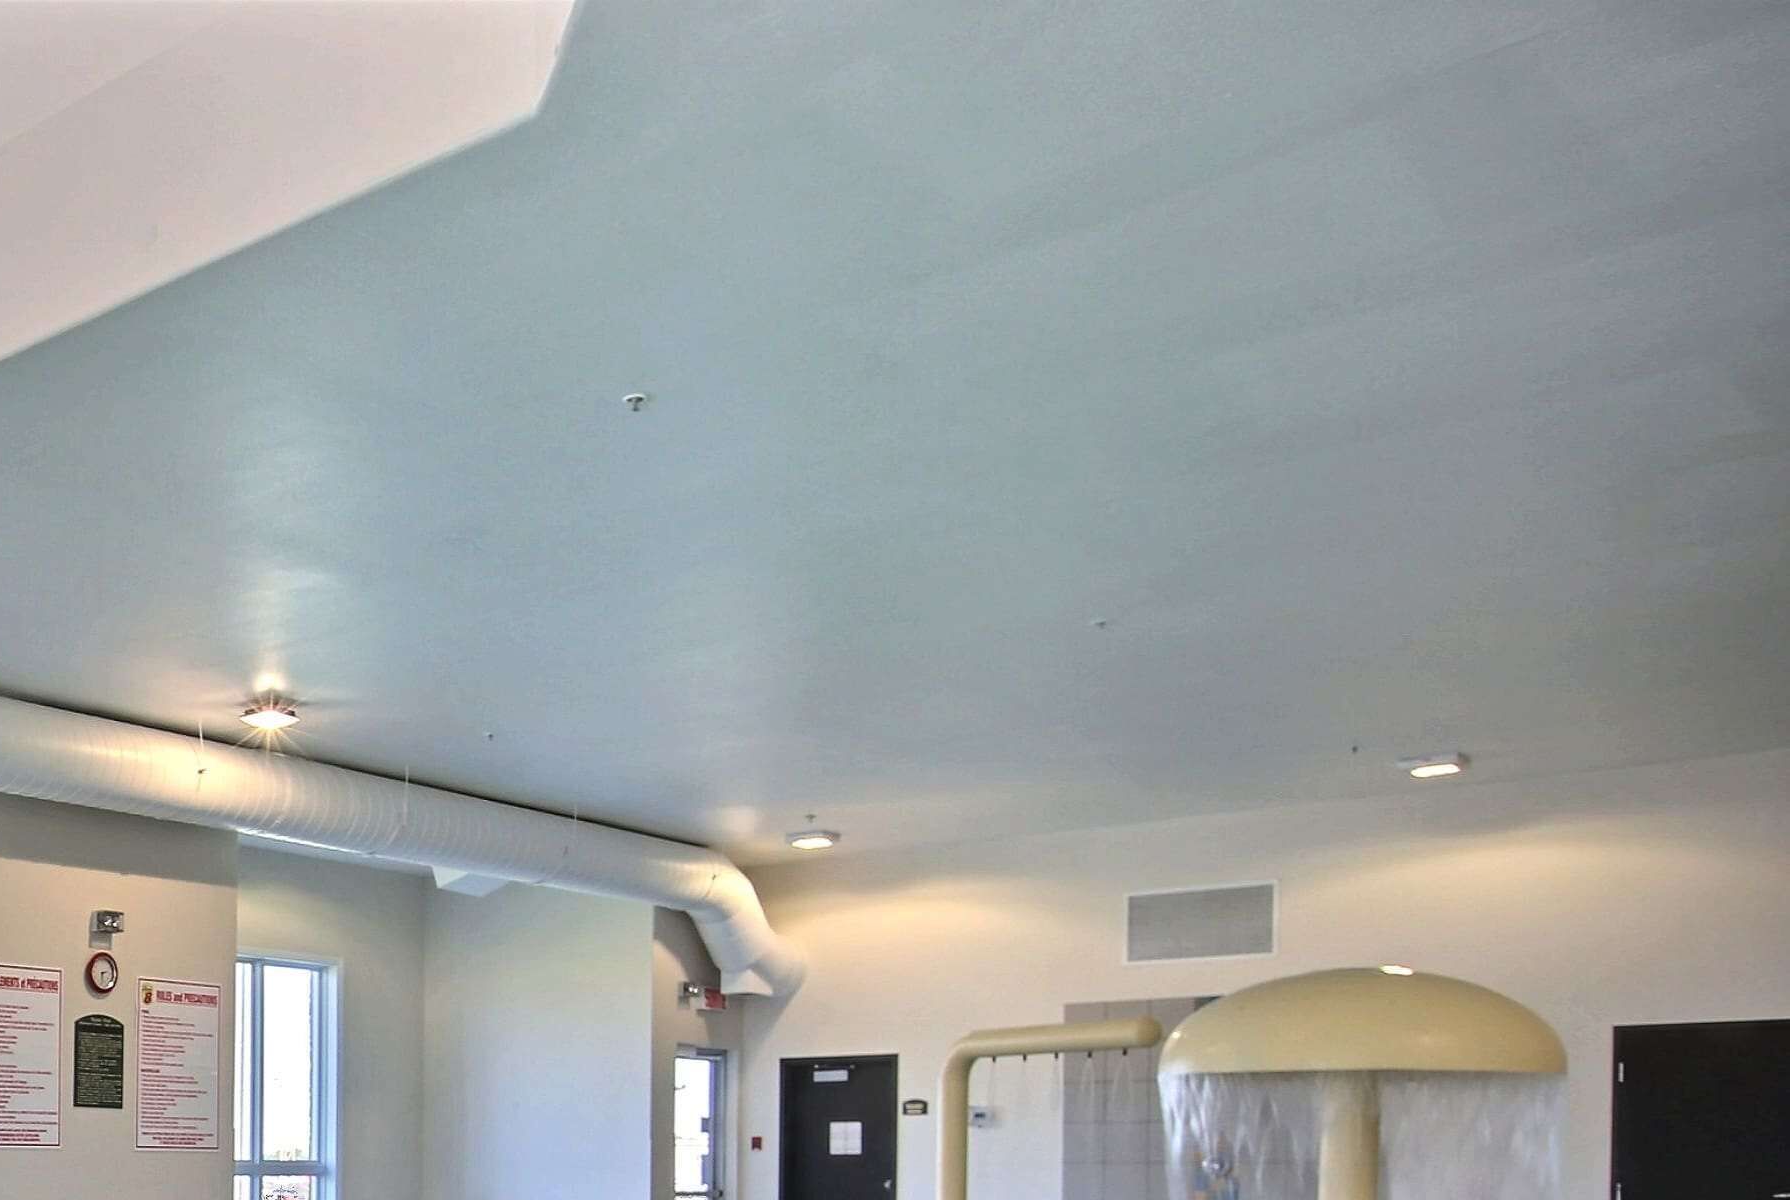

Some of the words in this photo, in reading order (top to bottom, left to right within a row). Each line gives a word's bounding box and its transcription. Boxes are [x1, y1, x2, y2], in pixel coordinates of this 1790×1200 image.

[144, 991, 153, 1004] 8
[156, 991, 172, 1002] RULES
[173, 994, 183, 1003] and
